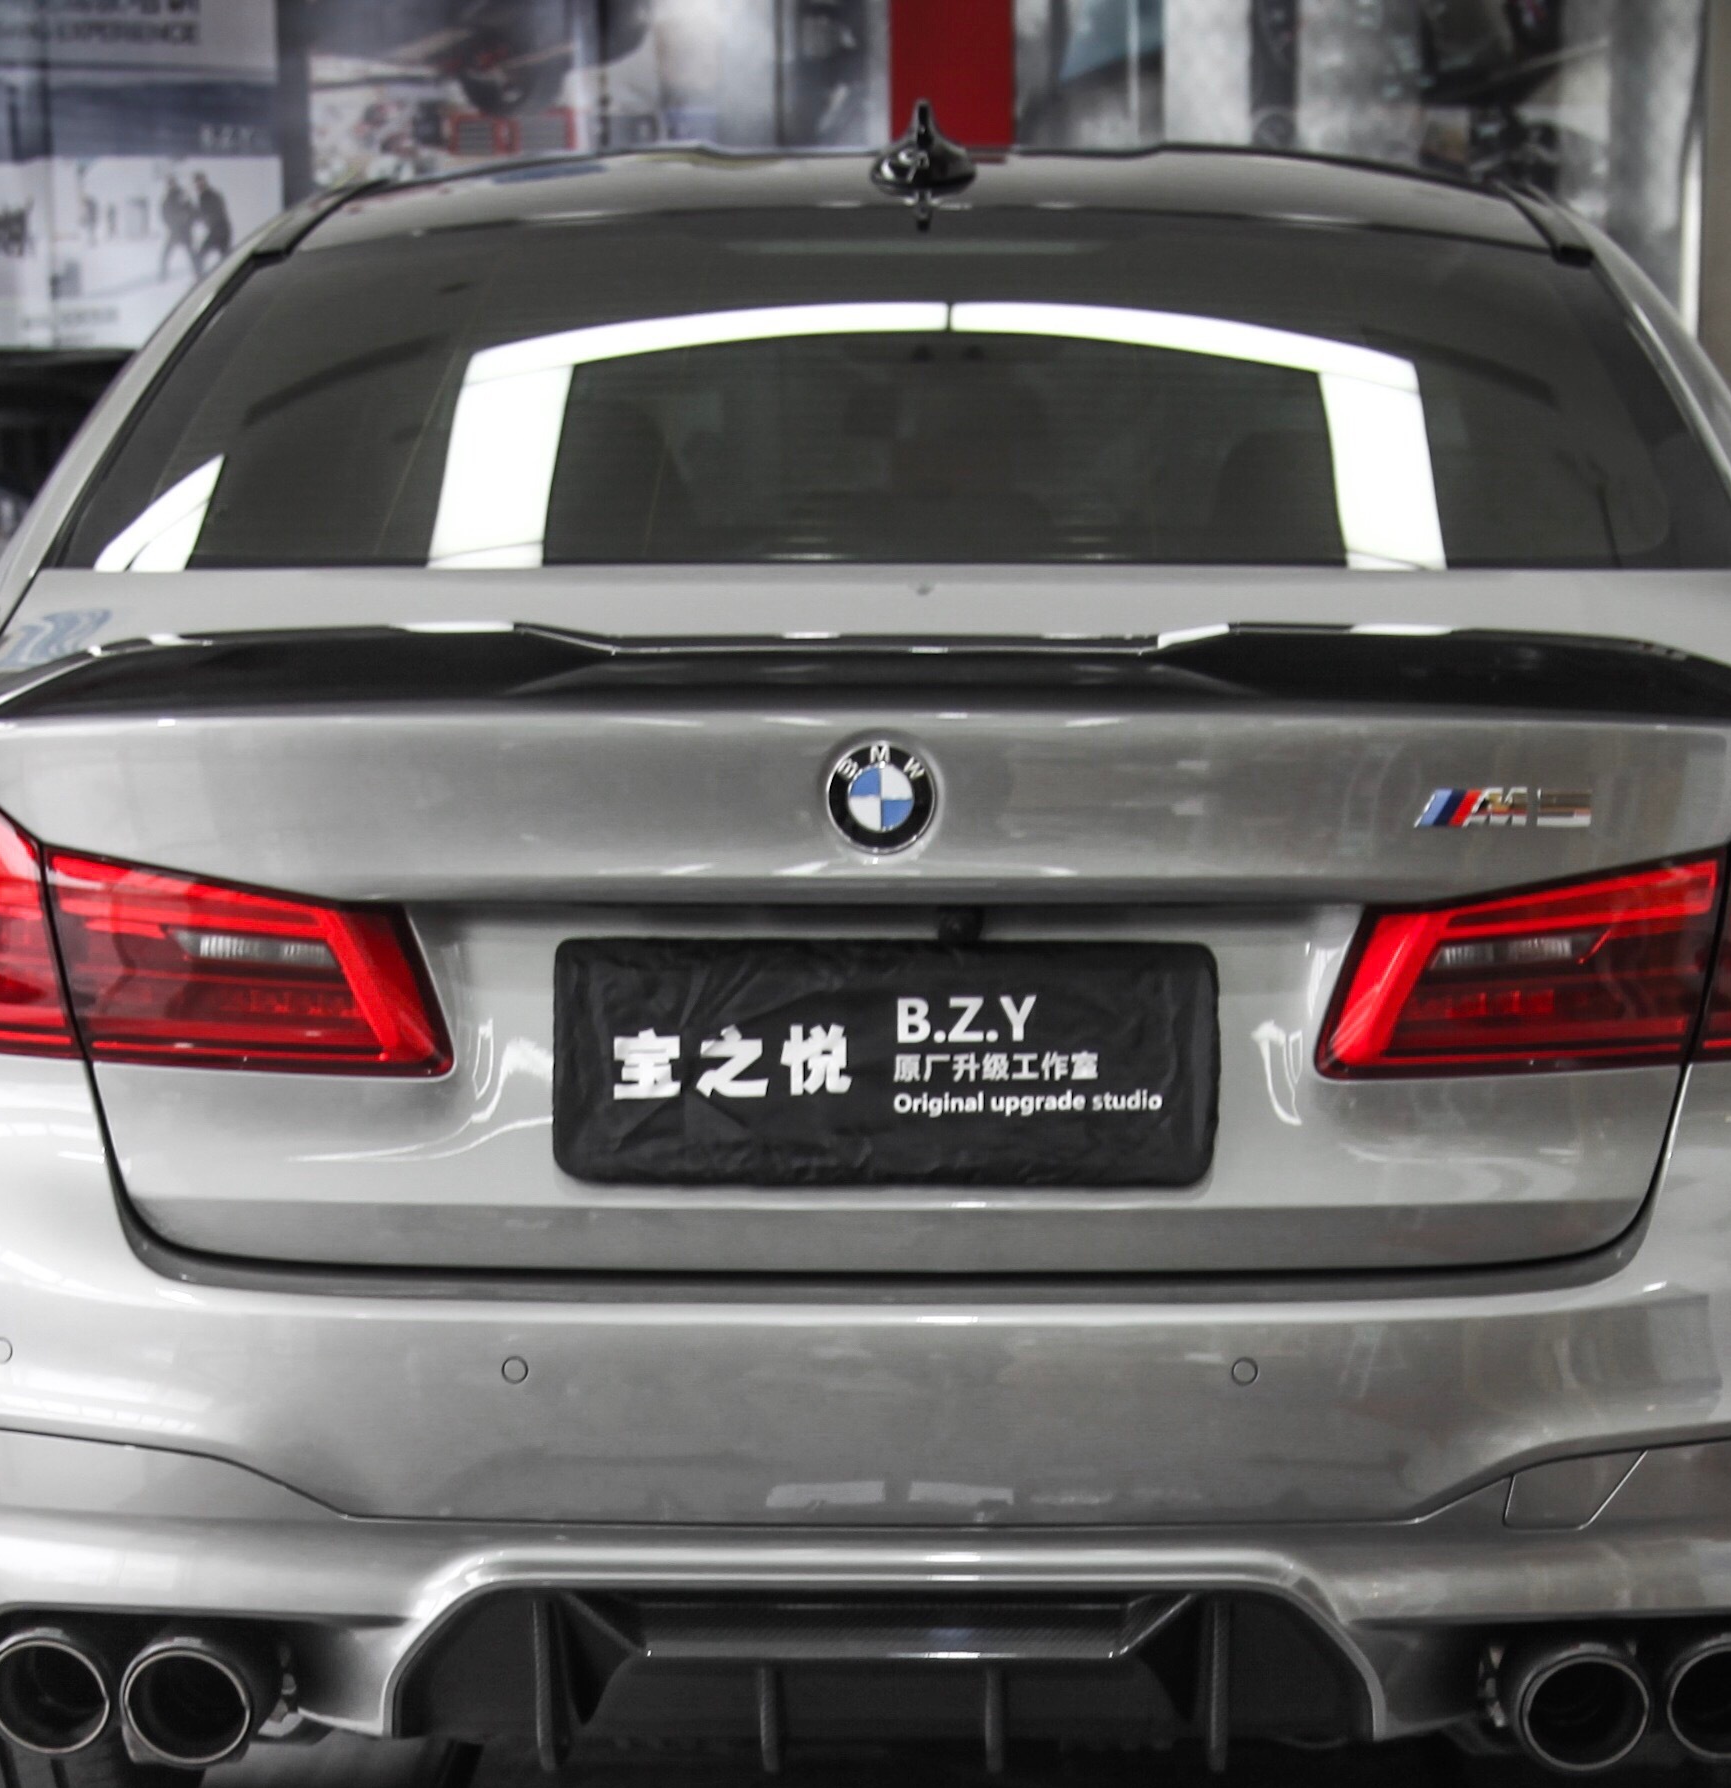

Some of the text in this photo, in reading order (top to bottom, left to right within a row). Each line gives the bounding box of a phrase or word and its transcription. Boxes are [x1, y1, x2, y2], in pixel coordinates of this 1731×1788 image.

[836, 742, 926, 780] BMW
[896, 995, 1037, 1044] B.Z.Y
[613, 1023, 853, 1101] 宝之悦
[892, 1050, 1100, 1083] 原厂升级工作室
[893, 1090, 1164, 1118] Original upgrade studio
